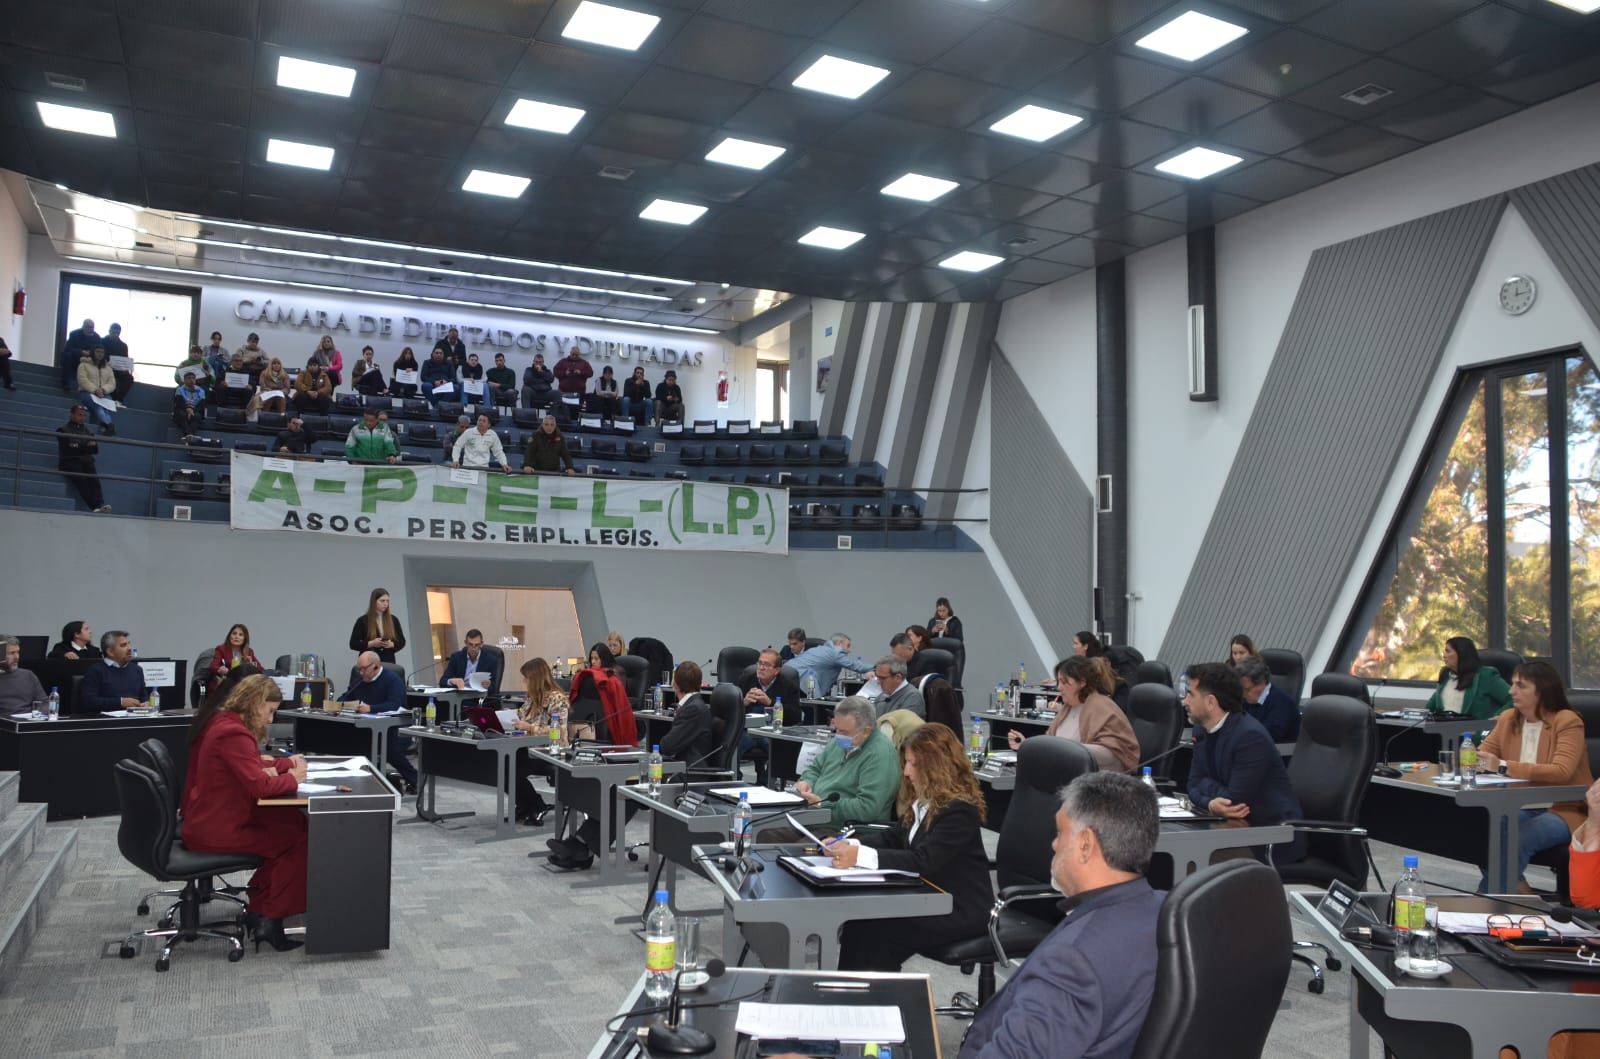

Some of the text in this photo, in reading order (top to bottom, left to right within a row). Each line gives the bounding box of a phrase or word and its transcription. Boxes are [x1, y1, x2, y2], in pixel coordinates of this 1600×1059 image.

[234, 299, 351, 332] CÁMARA
[359, 315, 392, 335] DE
[553, 335, 570, 354] Y
[575, 336, 704, 368] DIPUTADAS
[282, 510, 659, 547] ASOC. PERS. EMPL. LEGIS.
